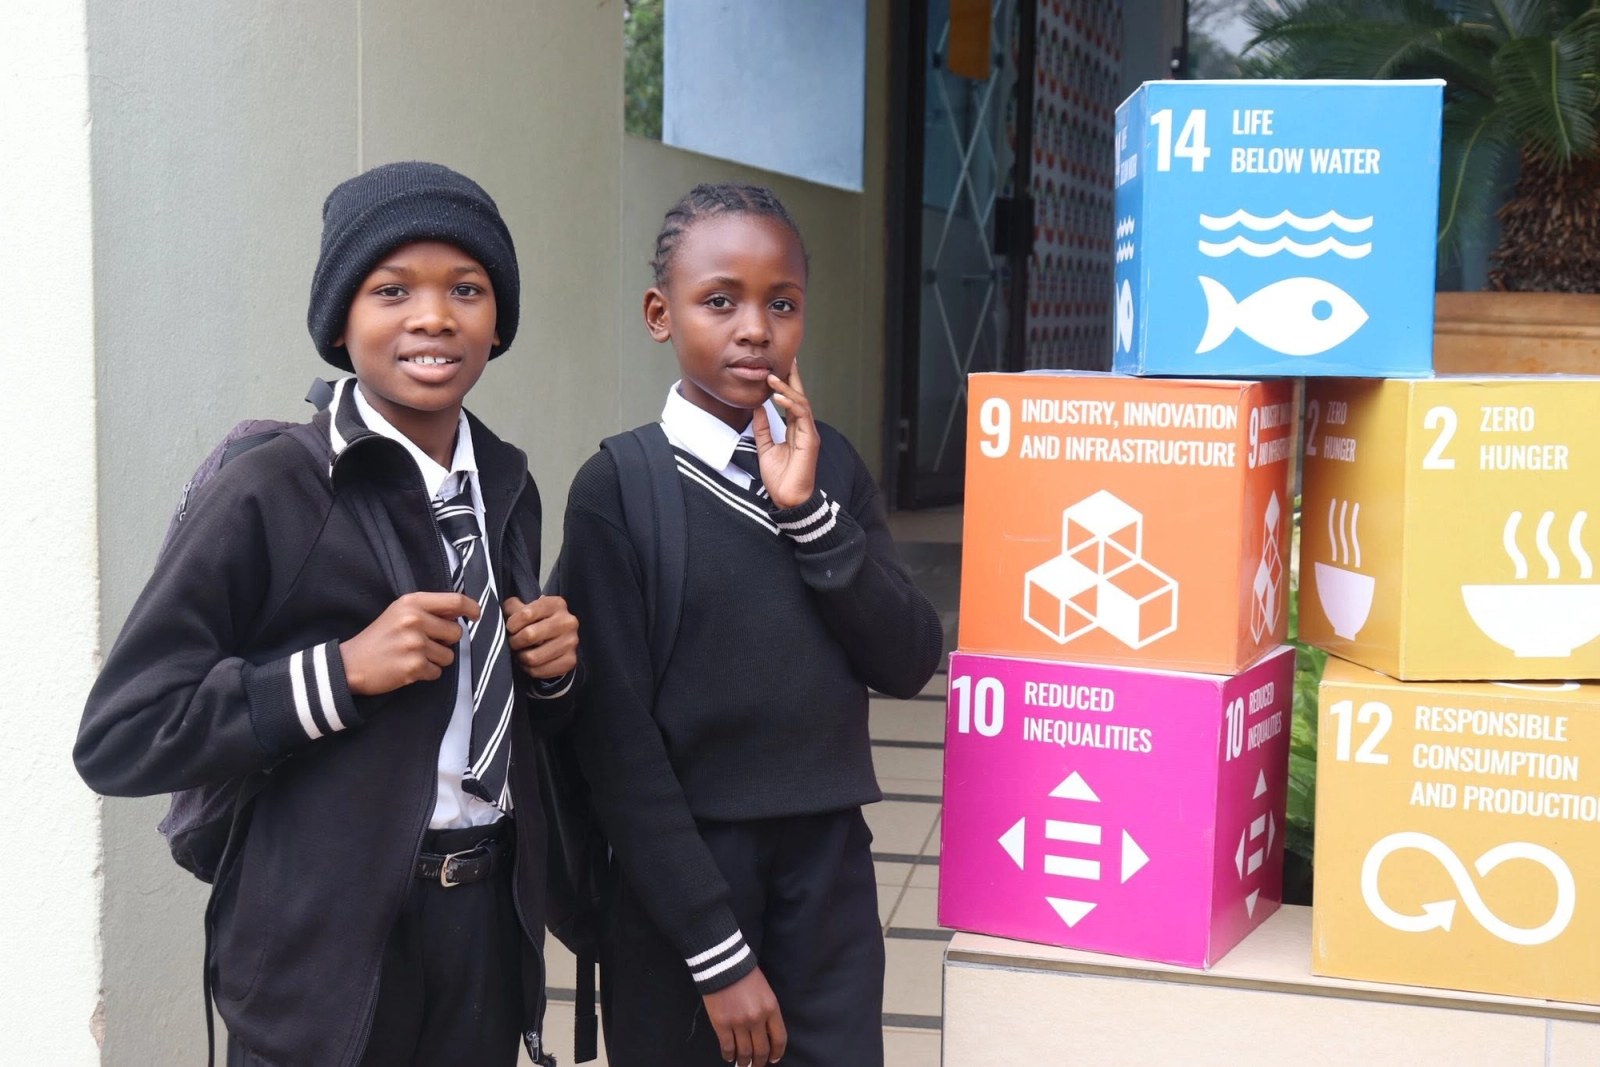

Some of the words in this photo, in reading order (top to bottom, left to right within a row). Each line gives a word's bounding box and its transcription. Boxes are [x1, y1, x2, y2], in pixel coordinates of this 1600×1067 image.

[1150, 108, 1212, 173] 14
[1232, 109, 1274, 136] LIFE
[1231, 146, 1304, 174] BELOW
[1310, 147, 1381, 175] WATER
[979, 396, 1012, 459] 9
[1021, 398, 1120, 429] INDUSTRY,
[1123, 401, 1238, 430] INNOVATION
[1306, 398, 1320, 457] 2
[1326, 400, 1348, 425] ZERO
[1480, 406, 1536, 433] ZERO
[1019, 434, 1061, 461] AND
[1065, 436, 1236, 468] INFRASTRUCTURE
[1247, 406, 1260, 470] 9
[1323, 435, 1356, 463] HUNGER
[1422, 405, 1459, 470] 2
[1479, 444, 1569, 471] HUNGER
[951, 675, 1005, 737] 10
[1024, 681, 1115, 713] REDUCED
[1249, 681, 1275, 716] REDUCED
[1023, 716, 1153, 754] INEQUALITIES
[1225, 696, 1245, 762] 10
[1329, 699, 1393, 765] 12
[1415, 705, 1569, 742] RESPONSIBLE
[1412, 743, 1579, 782] CONSUMPTION
[1409, 781, 1457, 809] AND
[1463, 785, 1600, 822] PRODUCTIO
